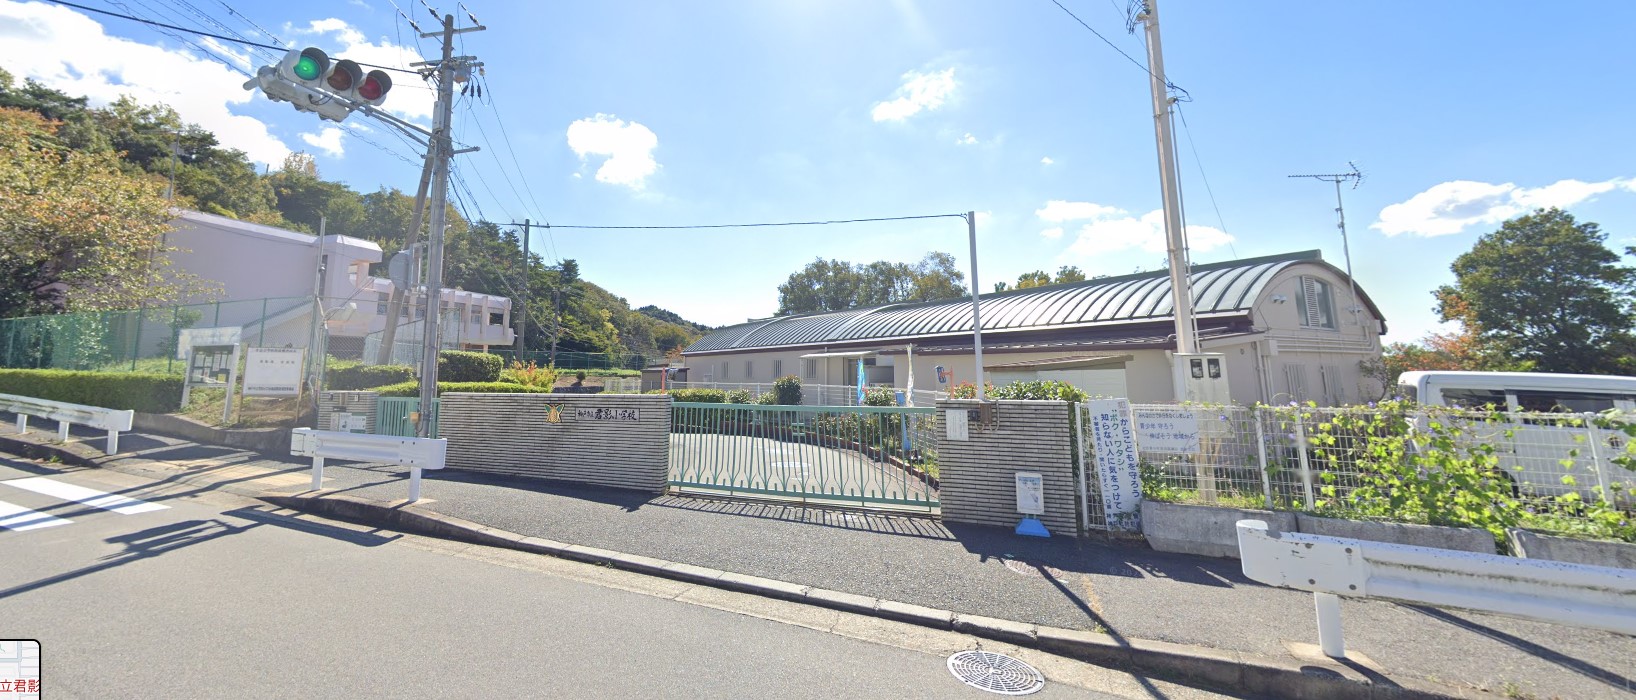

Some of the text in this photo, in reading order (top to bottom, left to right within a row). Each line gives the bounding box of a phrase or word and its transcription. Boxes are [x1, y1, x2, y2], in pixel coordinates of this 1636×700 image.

[1101, 413, 1122, 509] 知らない人に気をつけて
